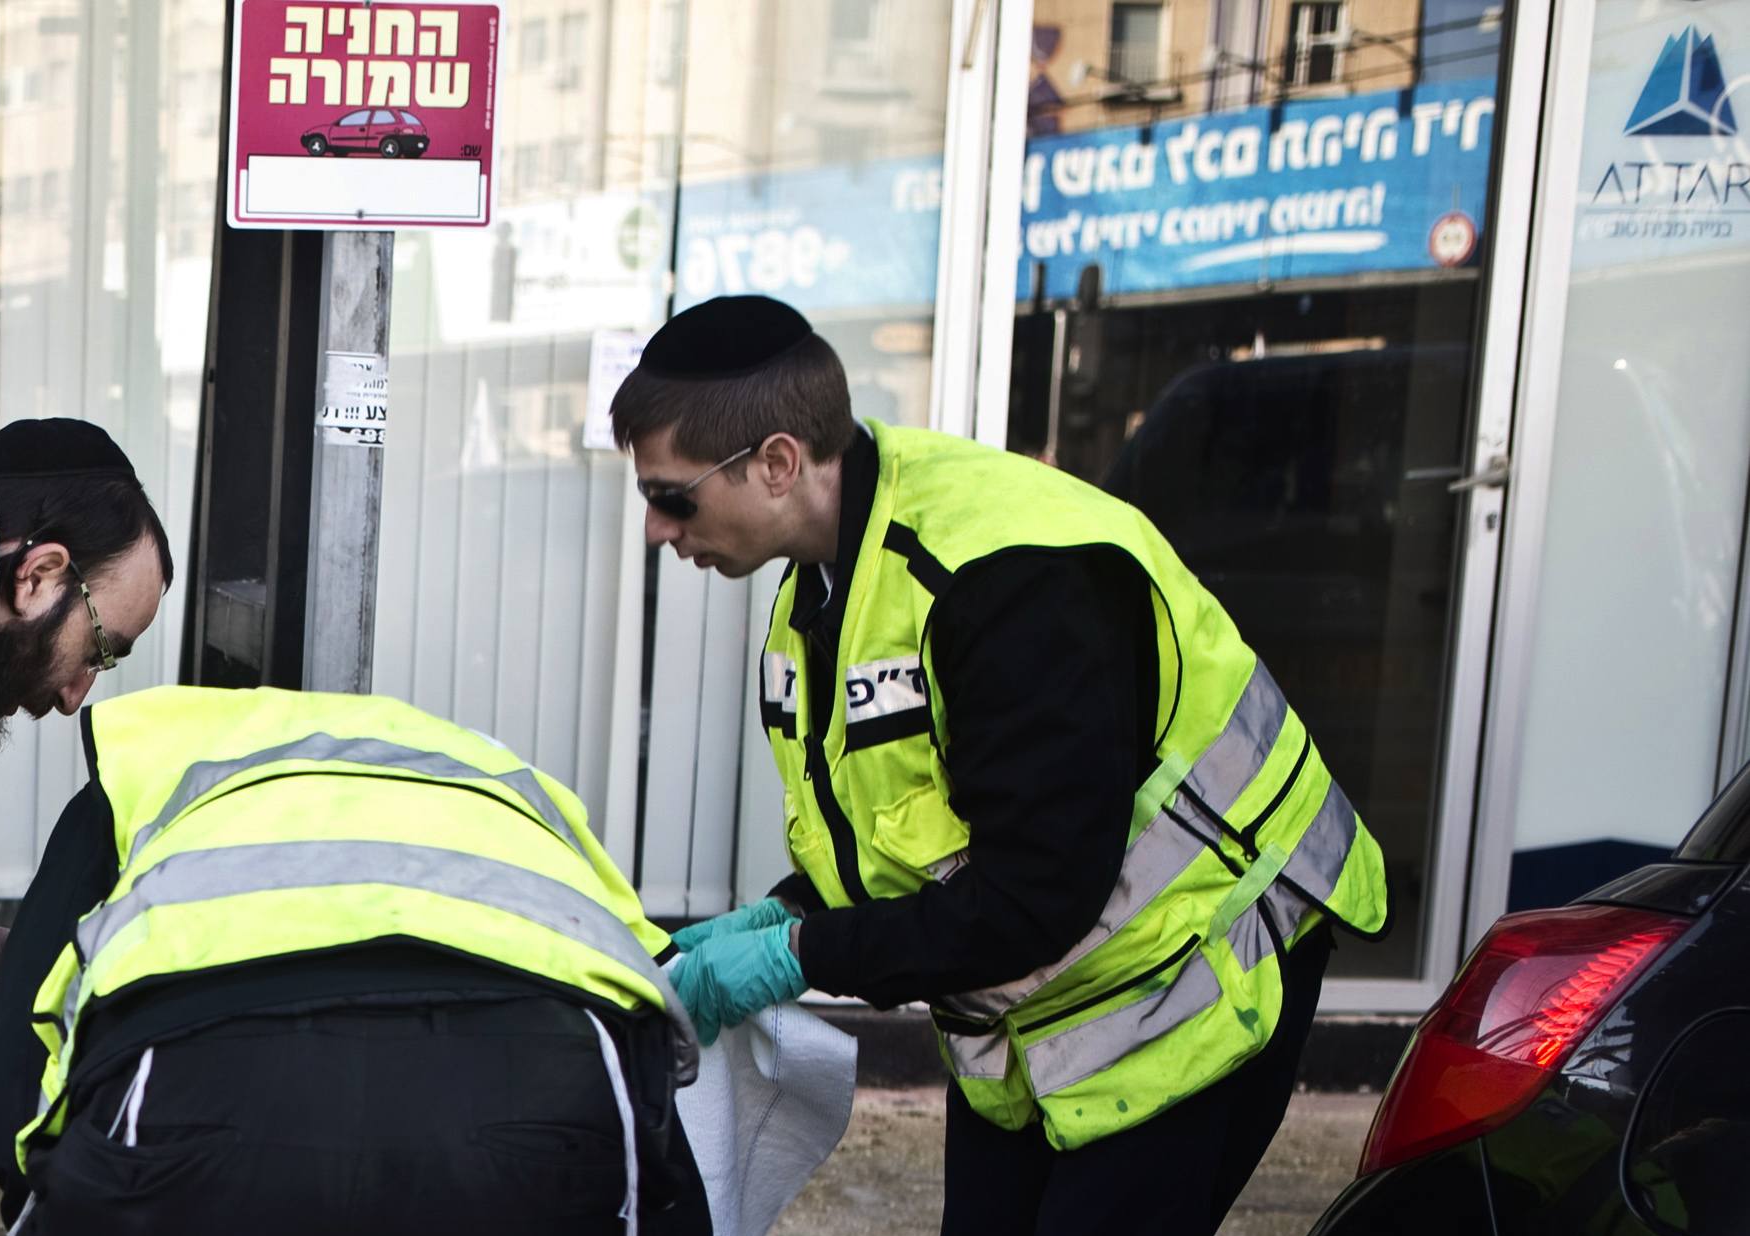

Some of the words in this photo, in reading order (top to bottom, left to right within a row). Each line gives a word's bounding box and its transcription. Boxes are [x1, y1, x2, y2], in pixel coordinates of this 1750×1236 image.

[284, 6, 459, 57] החניה
[268, 57, 471, 108] שמורה
[460, 144, 482, 157] שם:
[1592, 161, 1750, 204] ATTAR
